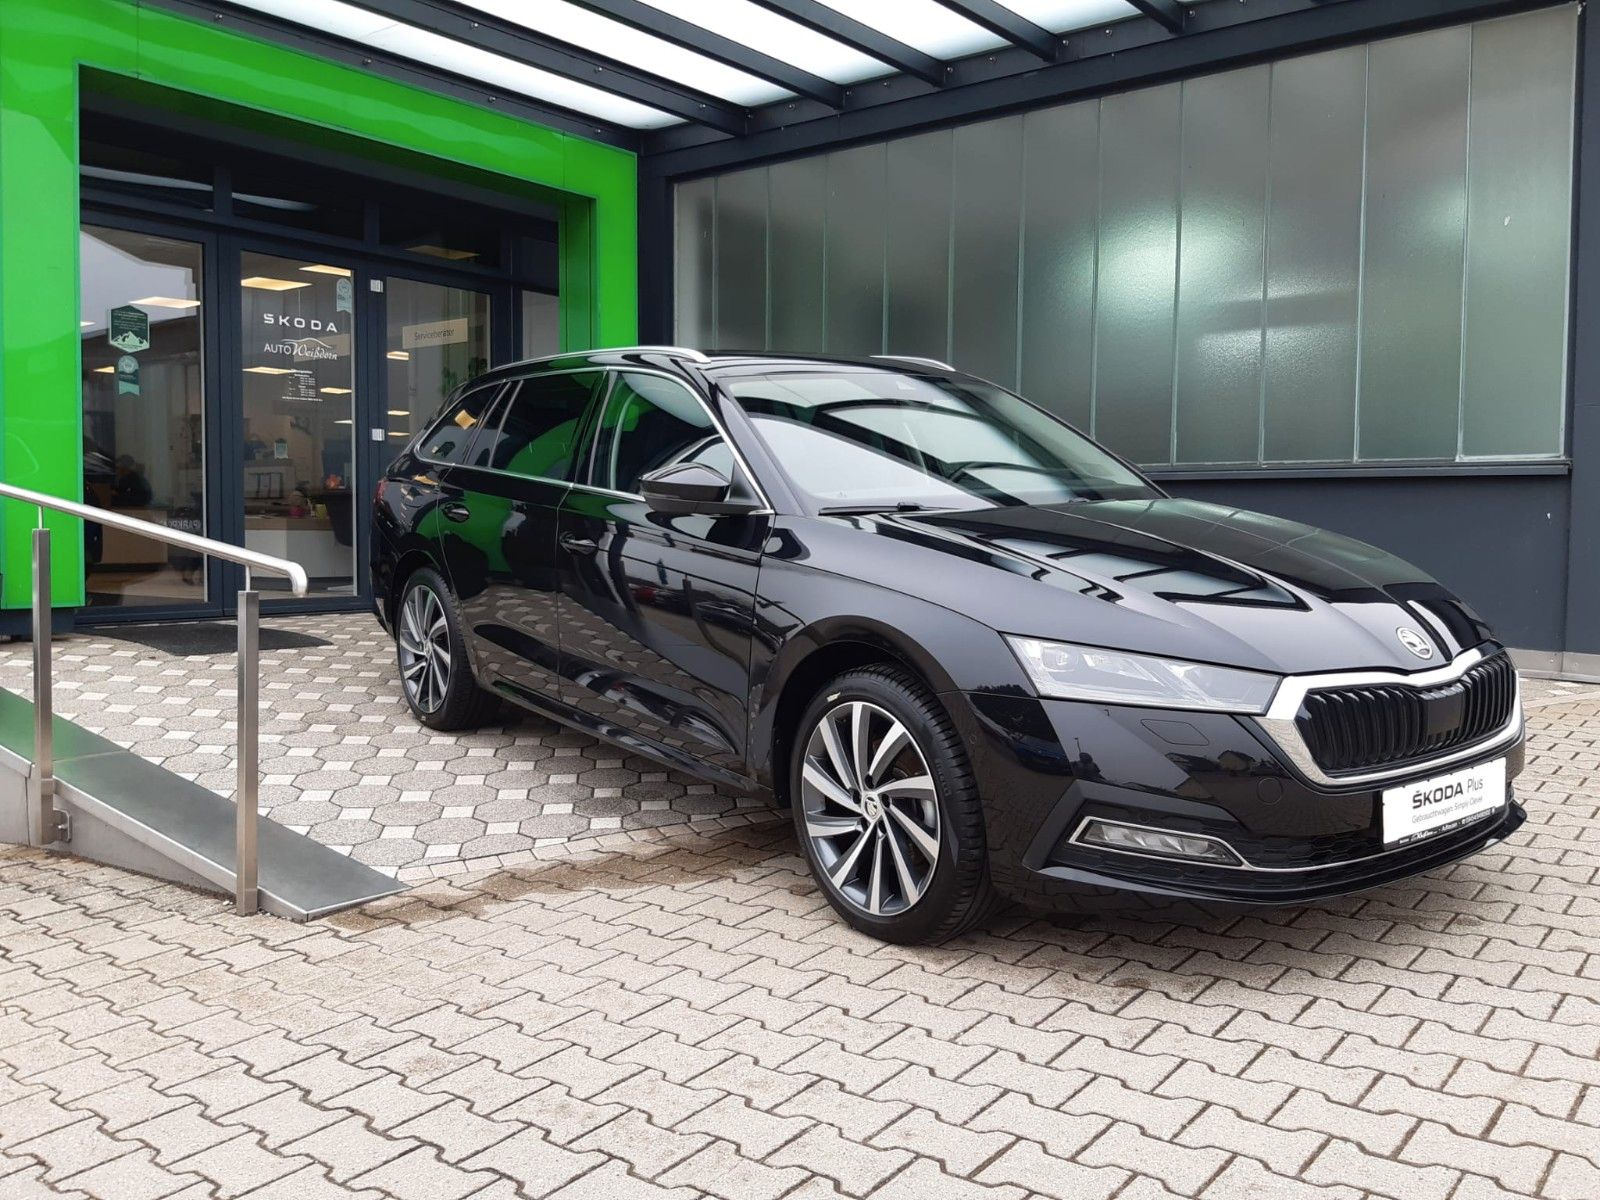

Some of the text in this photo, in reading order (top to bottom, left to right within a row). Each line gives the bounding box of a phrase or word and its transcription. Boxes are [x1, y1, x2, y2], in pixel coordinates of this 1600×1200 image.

[263, 342, 292, 355] AUTO
[1412, 776, 1484, 810] ŠKODA Plus
